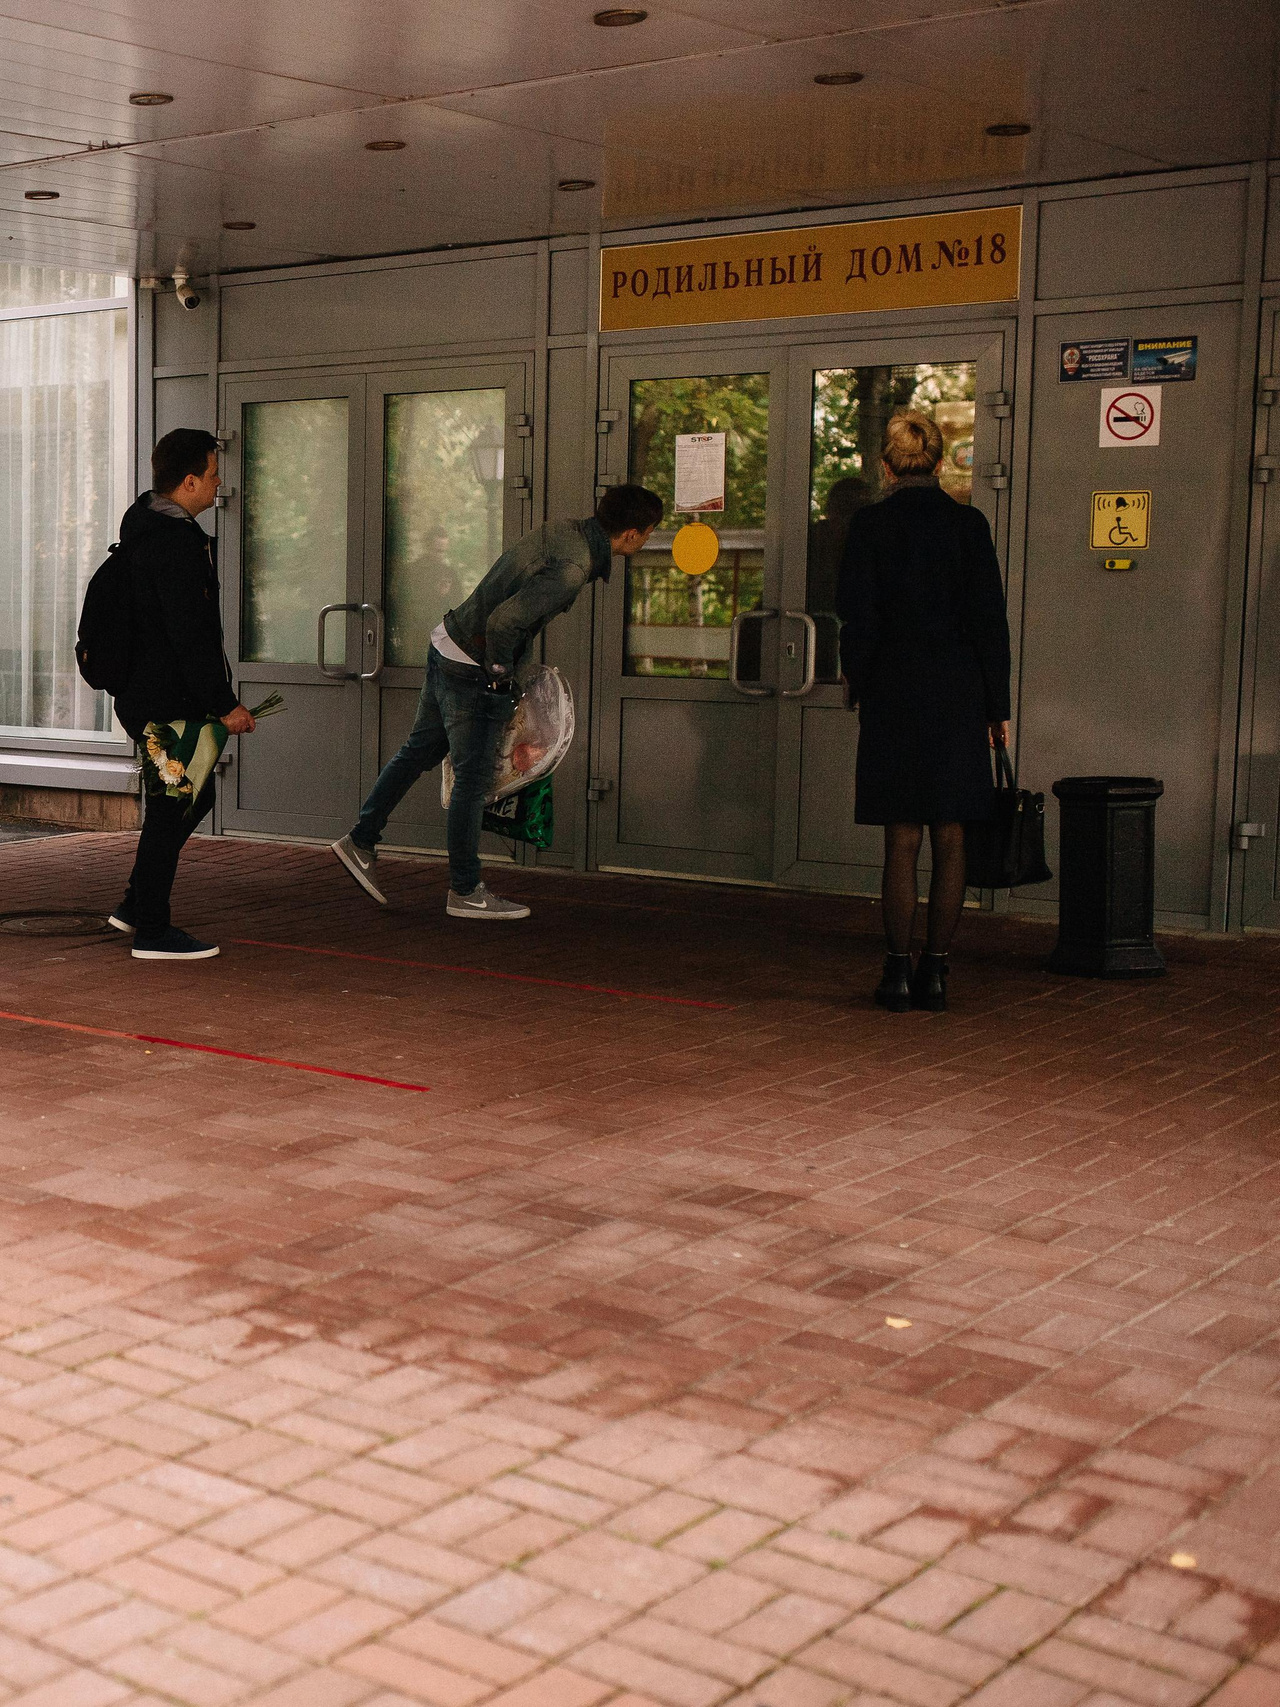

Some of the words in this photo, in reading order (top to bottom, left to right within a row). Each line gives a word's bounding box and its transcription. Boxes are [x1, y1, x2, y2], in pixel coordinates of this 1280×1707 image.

[612, 244, 824, 302] РОДИЛЬНЫЙ
[845, 242, 924, 284] ДОМ
[931, 232, 1008, 269] №18
[1138, 341, 1192, 350] ВНИМАНИЕ
